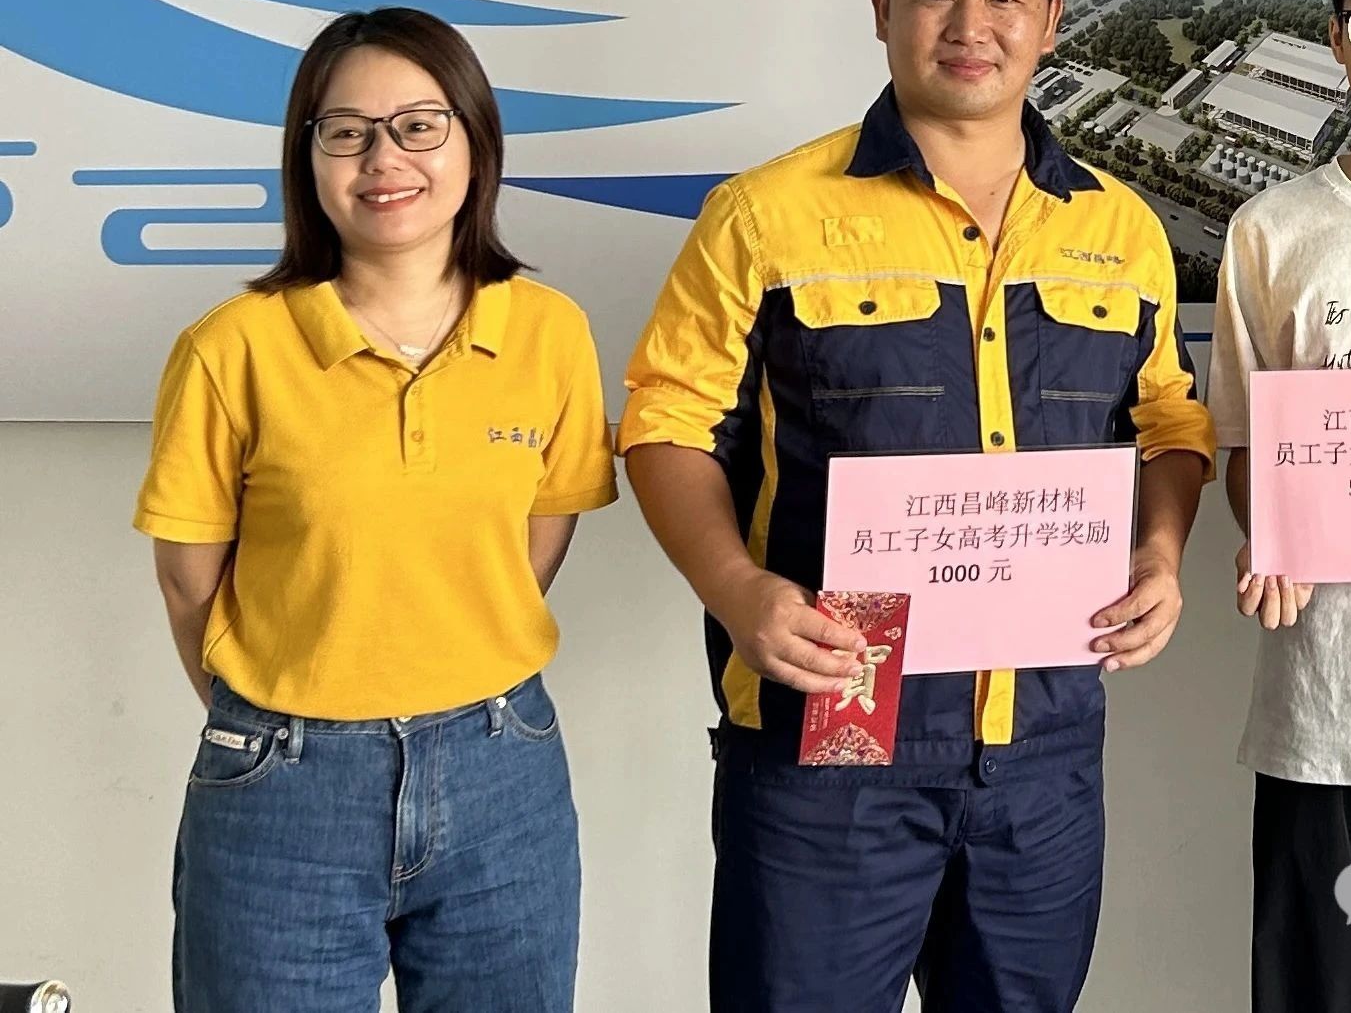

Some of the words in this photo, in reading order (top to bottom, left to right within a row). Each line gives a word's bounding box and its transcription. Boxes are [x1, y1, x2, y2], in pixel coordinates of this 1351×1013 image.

[487, 426, 545, 448] 江西昌
[905, 486, 1087, 519] 江西昌峰新材料
[850, 519, 1110, 555] 员工子女高考升学奖励
[928, 563, 980, 584] 1000
[987, 558, 1012, 584] 元
